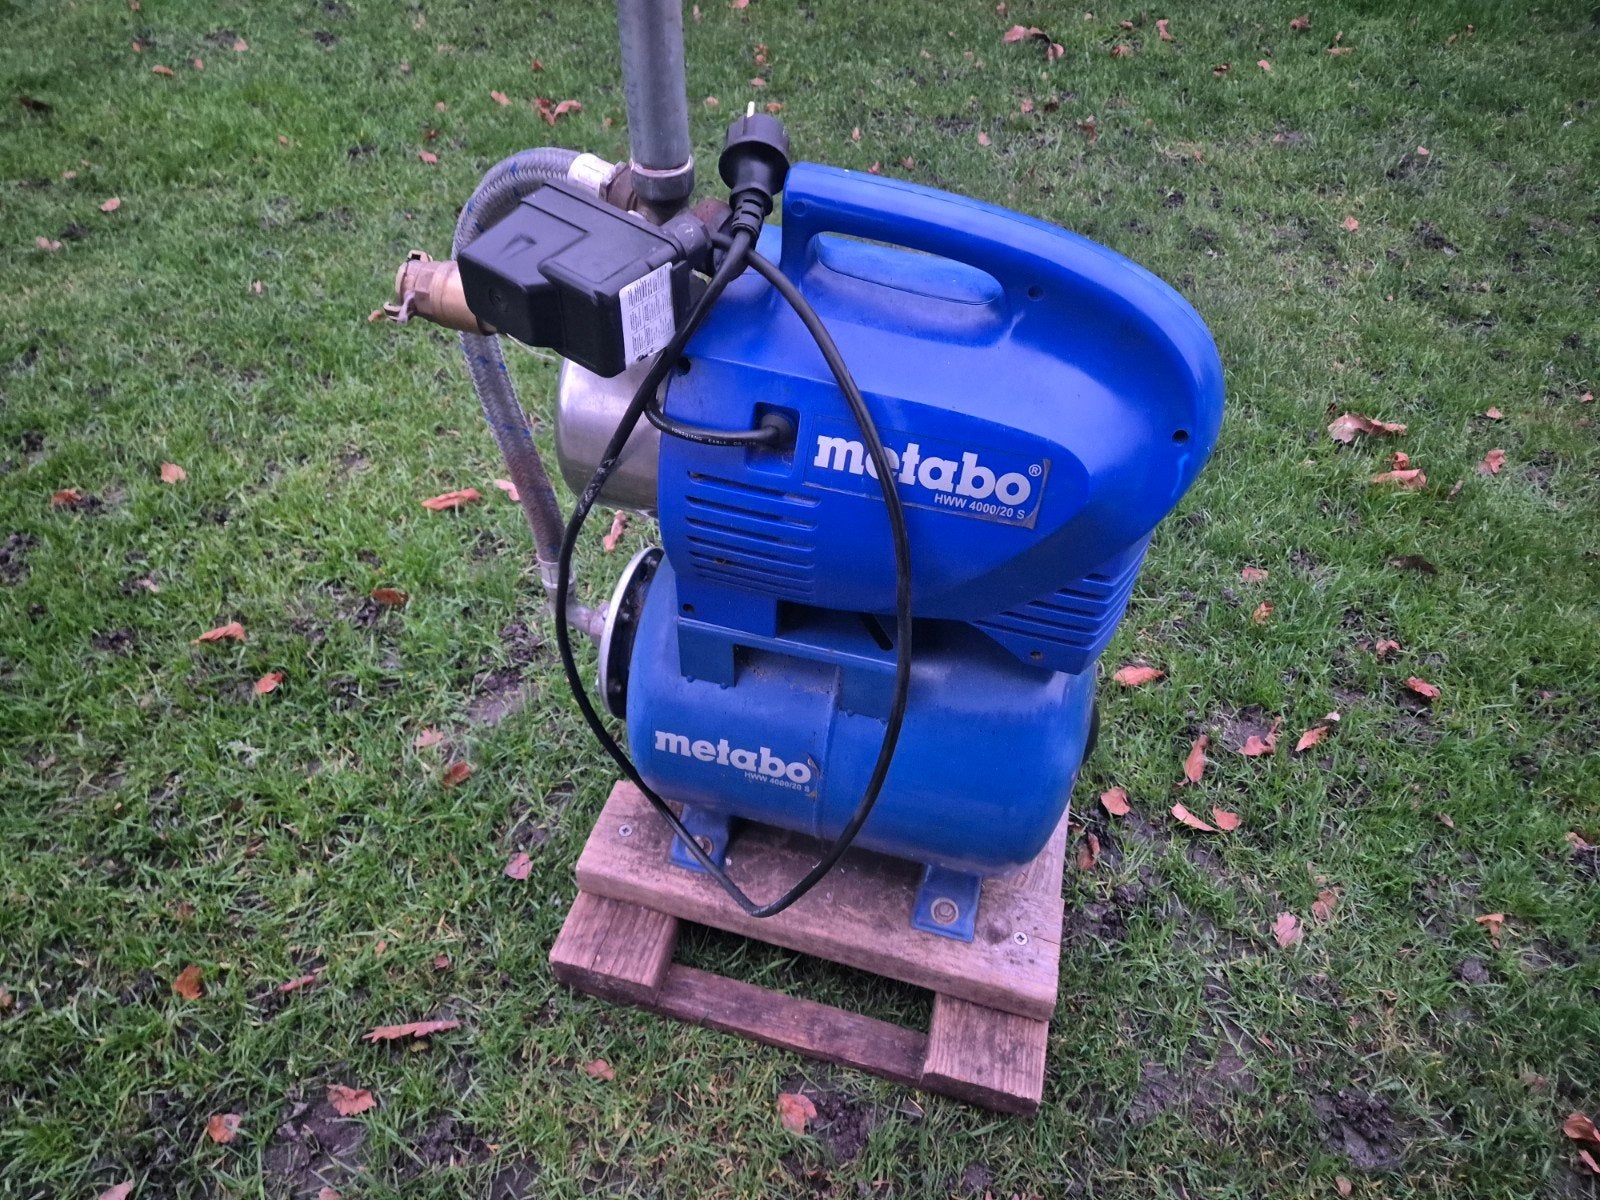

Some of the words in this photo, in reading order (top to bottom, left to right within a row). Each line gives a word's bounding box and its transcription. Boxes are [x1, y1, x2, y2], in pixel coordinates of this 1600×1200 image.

[934, 493, 967, 509] HWW
[968, 500, 1014, 518] 4000/20
[1016, 509, 1026, 520] S
[654, 730, 811, 784] metabo
[744, 771, 768, 782] HWW
